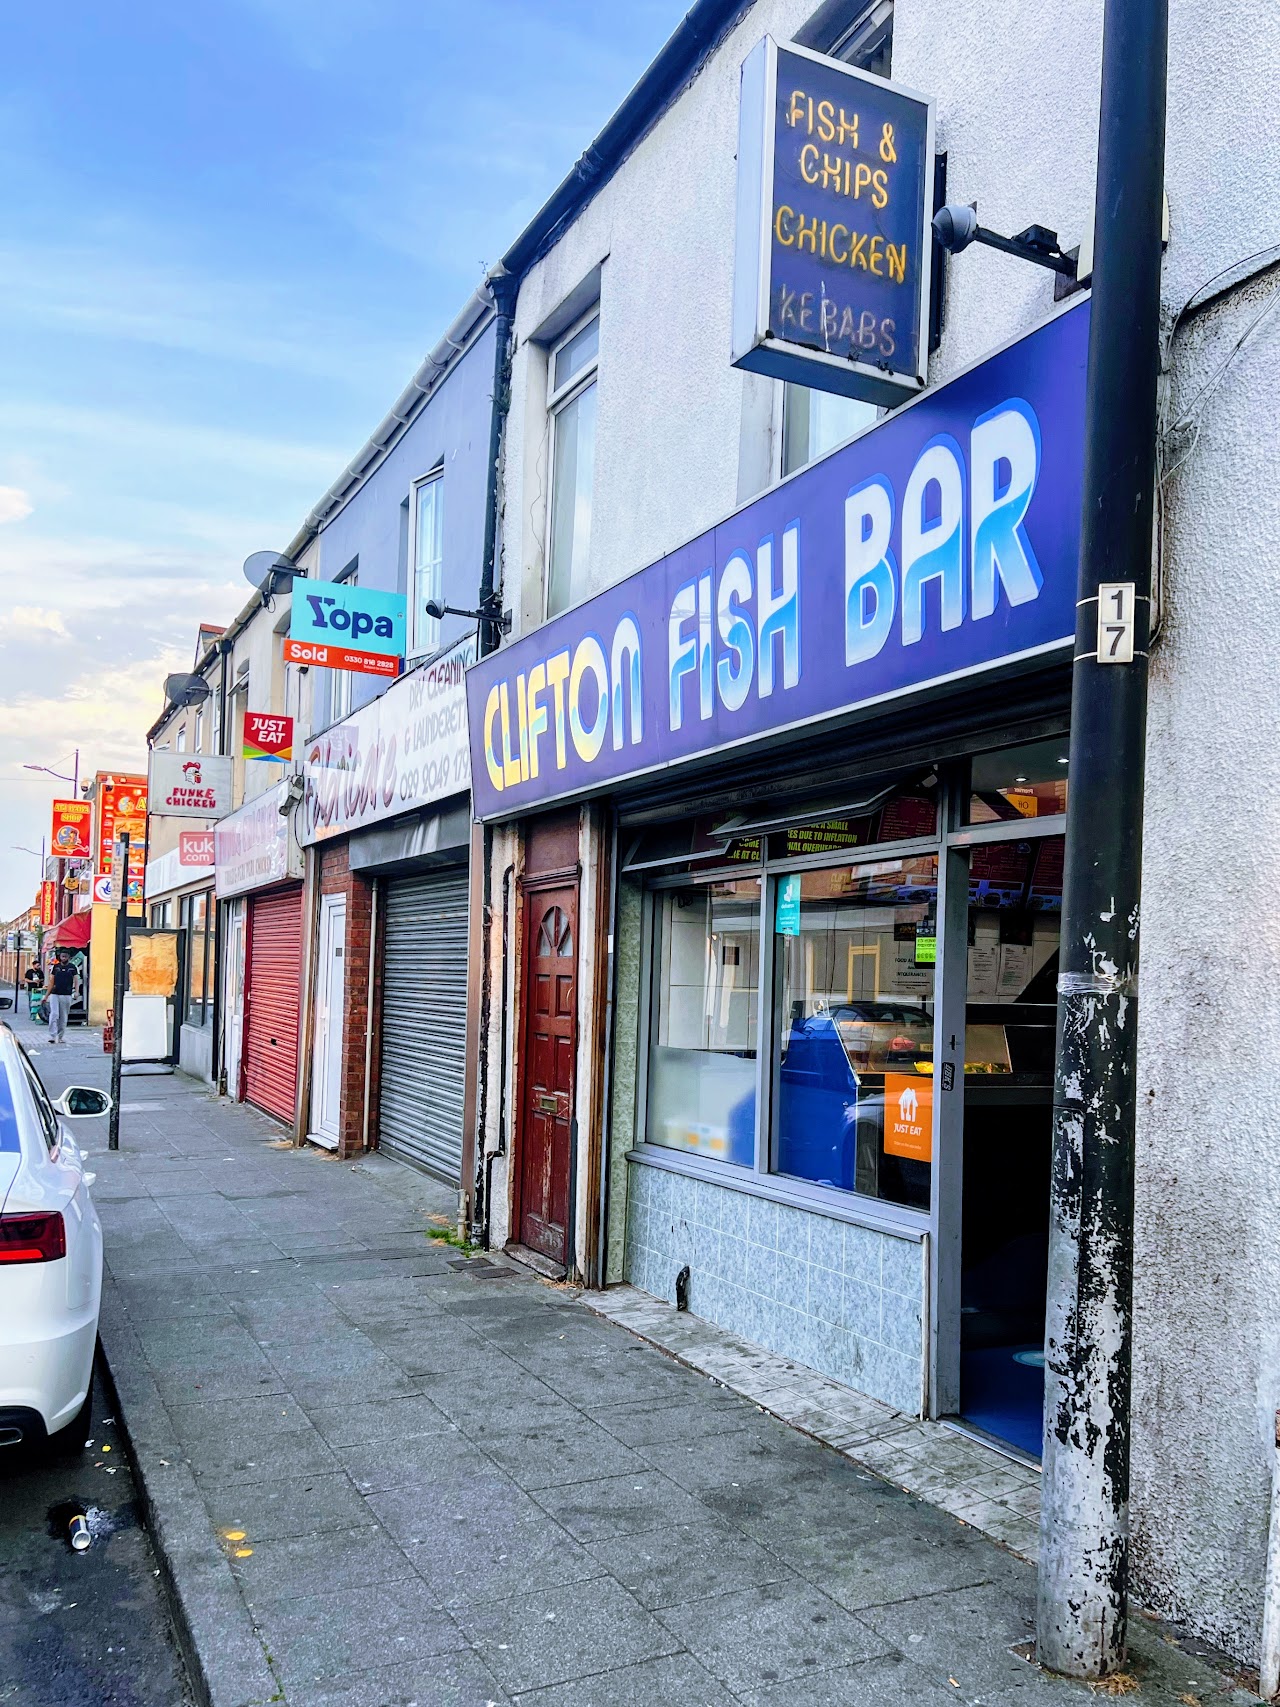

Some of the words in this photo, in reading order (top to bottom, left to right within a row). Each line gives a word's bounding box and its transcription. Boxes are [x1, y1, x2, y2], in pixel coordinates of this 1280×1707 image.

[790, 90, 859, 149] FISH
[879, 122, 897, 163] &
[801, 144, 889, 209] CHIPS
[776, 205, 907, 284] CHICKEN
[780, 283, 897, 357] KEBABS
[484, 610, 644, 791] CLIFTON
[668, 517, 801, 731] FISH
[845, 397, 1044, 668] BAR
[306, 594, 394, 639] Yopa
[290, 643, 328, 662] Sold
[344, 655, 363, 664] 0330
[409, 678, 424, 712] DRY
[427, 643, 474, 698] CLEANING
[251, 717, 286, 733] JUST
[413, 696, 466, 752] LAUNDERETT
[258, 730, 286, 745] EAT
[400, 768, 419, 801] 029
[422, 753, 450, 796] 2049
[454, 747, 471, 783] 179
[165, 796, 216, 809] CHICKEN
[172, 787, 215, 800] FUNKE
[788, 829, 798, 839] ES
[799, 830, 813, 840] DUE
[814, 831, 823, 841] TO
[823, 833, 858, 844] INFLATION
[827, 821, 848, 831] SMALL
[183, 852, 210, 862] .com
[787, 842, 801, 851] NAL
[894, 1123, 909, 1134] JUST
[909, 1125, 922, 1137] EAT
